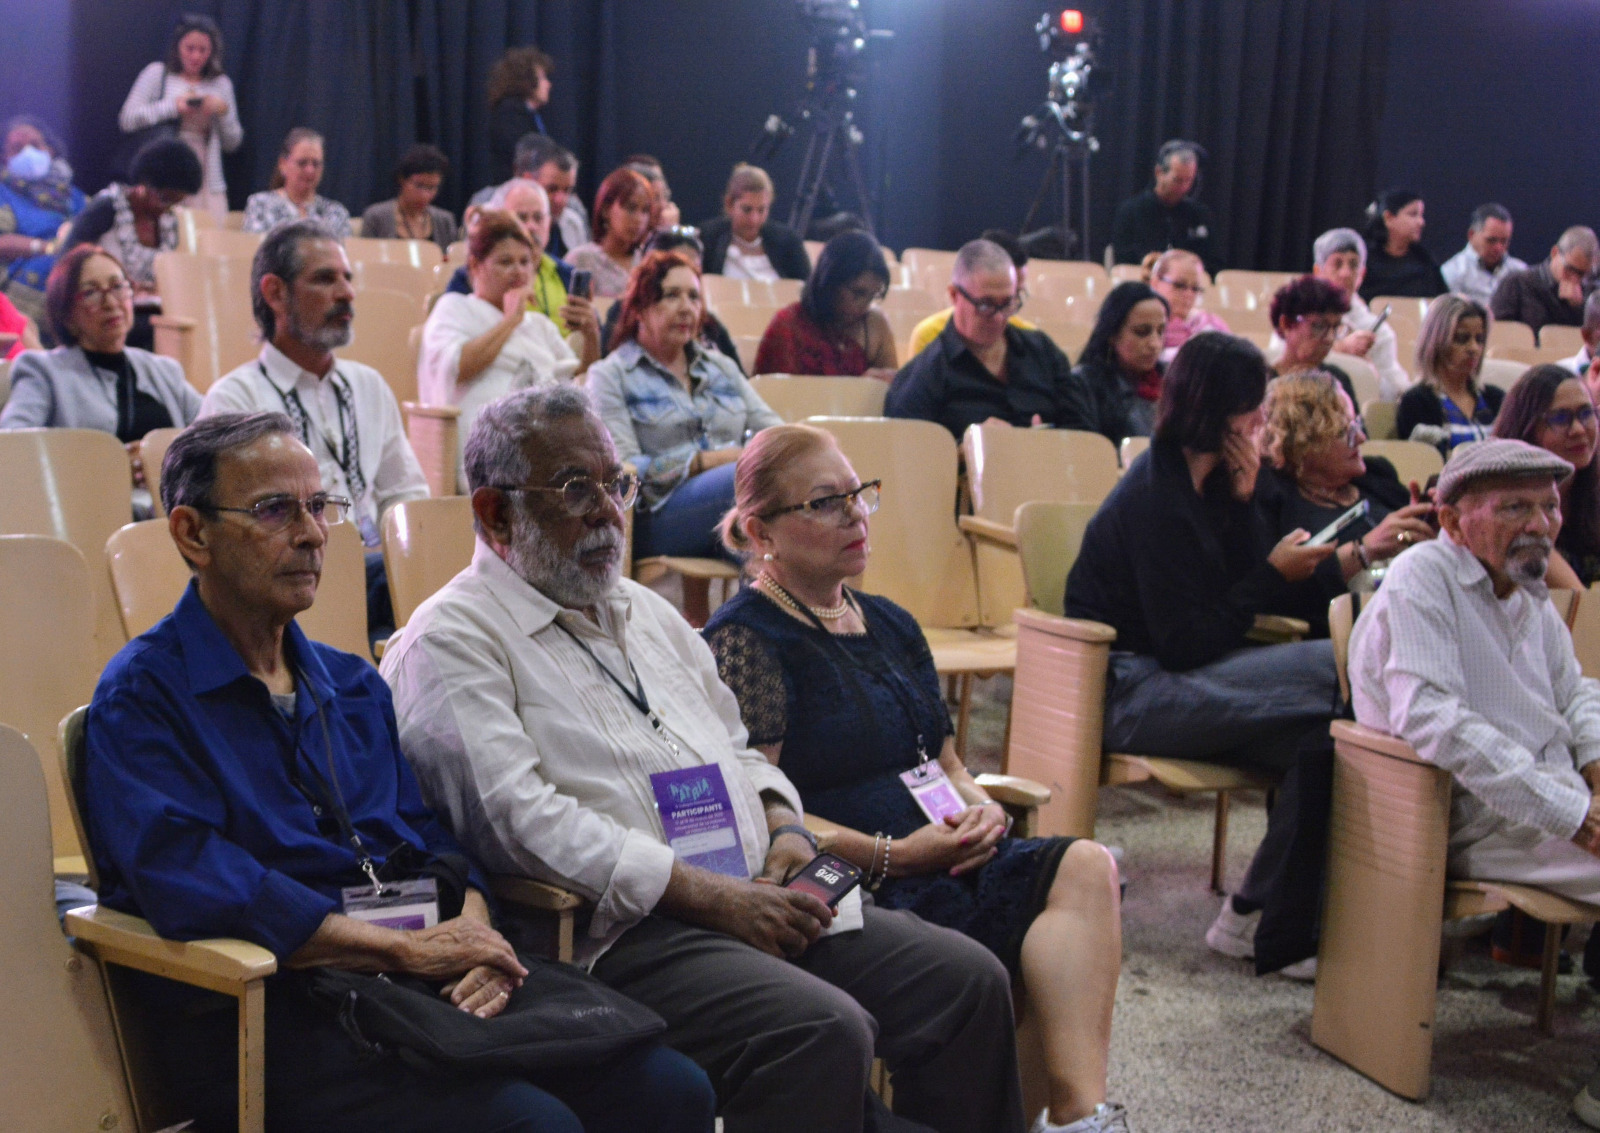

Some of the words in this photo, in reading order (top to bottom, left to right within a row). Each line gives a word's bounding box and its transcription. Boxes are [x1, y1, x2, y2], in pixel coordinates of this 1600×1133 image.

[669, 778, 709, 802] PATRIA
[671, 802, 723, 820] PARTICIPANTE
[815, 869, 839, 885] 9:48
